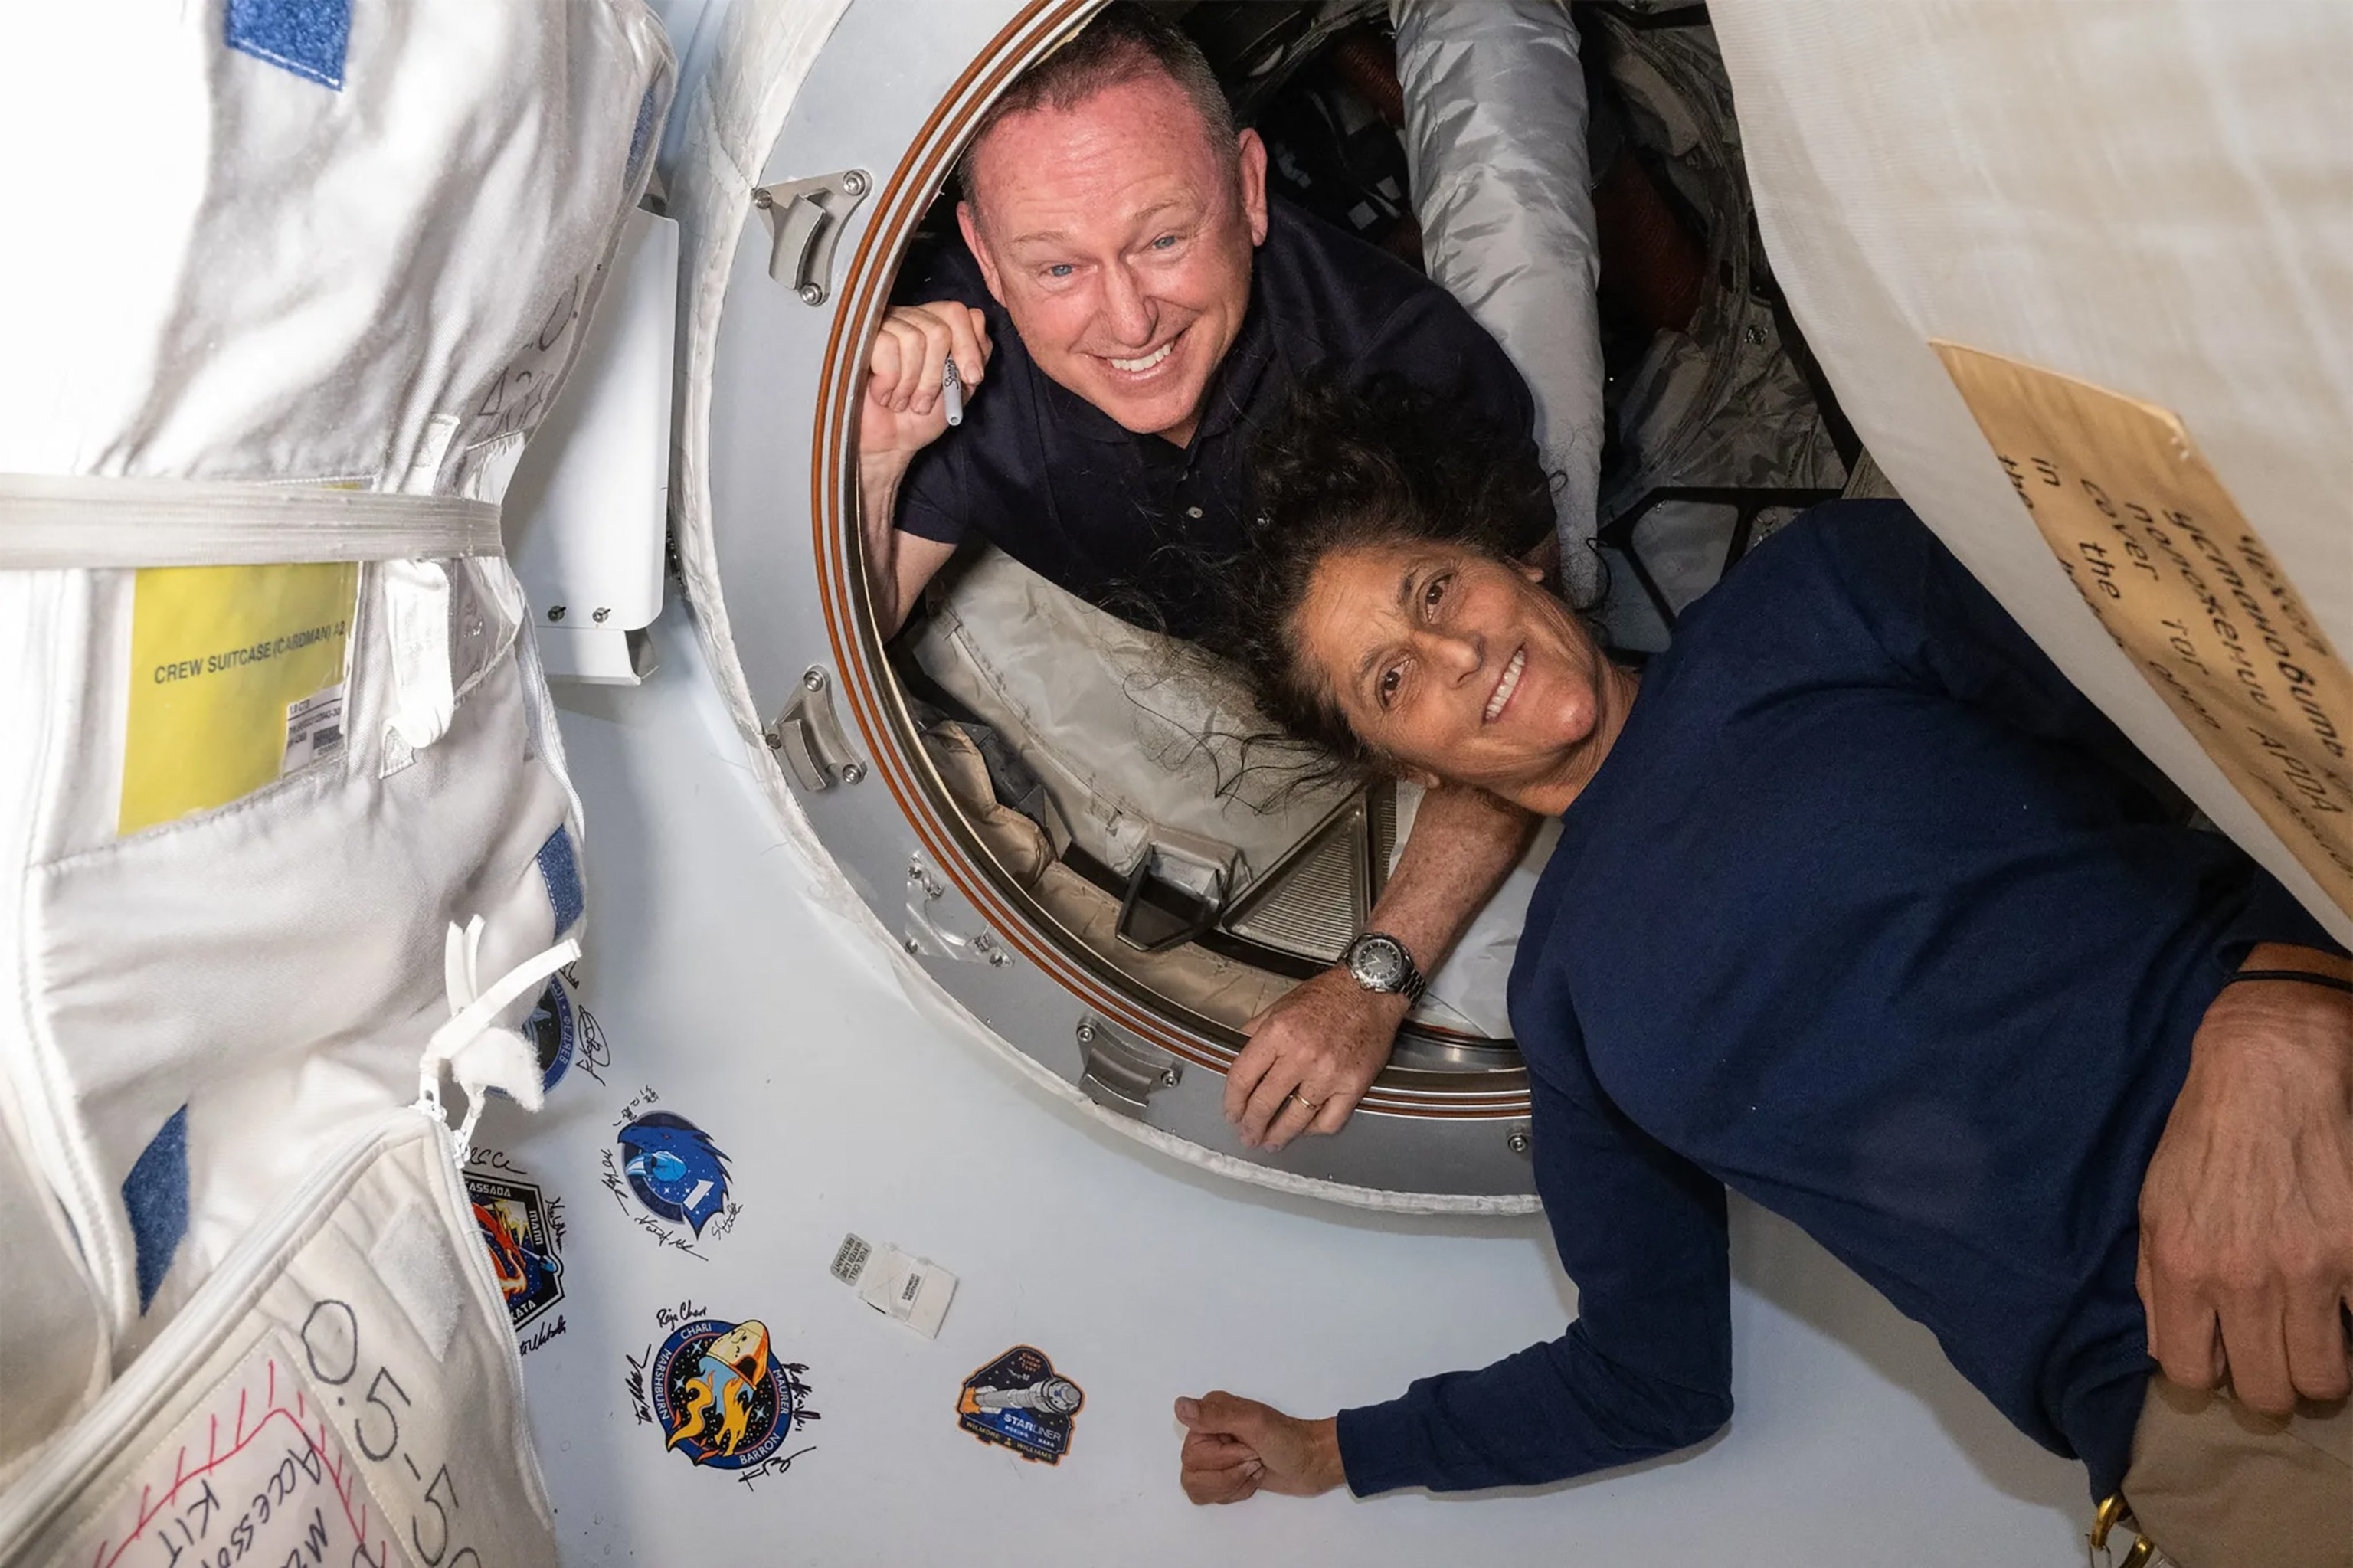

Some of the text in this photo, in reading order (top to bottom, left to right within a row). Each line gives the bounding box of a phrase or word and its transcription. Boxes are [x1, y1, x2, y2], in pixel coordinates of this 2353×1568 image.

[2030, 457, 2061, 487] in
[2078, 541, 2122, 599] the
[2080, 477, 2159, 581] cover
[154, 658, 204, 684] CREW
[208, 642, 271, 673] SUITCASE
[273, 624, 331, 657] (CARDMAN)
[558, 1016, 573, 1065] ФЕДЯЕВ
[529, 1210, 543, 1245] MANN
[833, 1237, 855, 1272] RESTRAINT
[839, 1242, 862, 1278] WATER LINE
[848, 1247, 869, 1280] FUEL CELL
[907, 1275, 921, 1301] RESTRAINT
[680, 1323, 712, 1340] CHARI
[655, 1348, 672, 1420] MARSHBURN
[773, 1369, 790, 1415] MAURER
[302, 1299, 481, 1568] 0.5-5
[966, 1421, 1053, 1459] WILMORE WILLIAMS
[1003, 1413, 1062, 1442] STARLINER
[1005, 1425, 1029, 1438] BOEING
[739, 1432, 781, 1465] BARRON
[201, 1432, 321, 1568] ACCESSO
[158, 1478, 220, 1568] KIT
